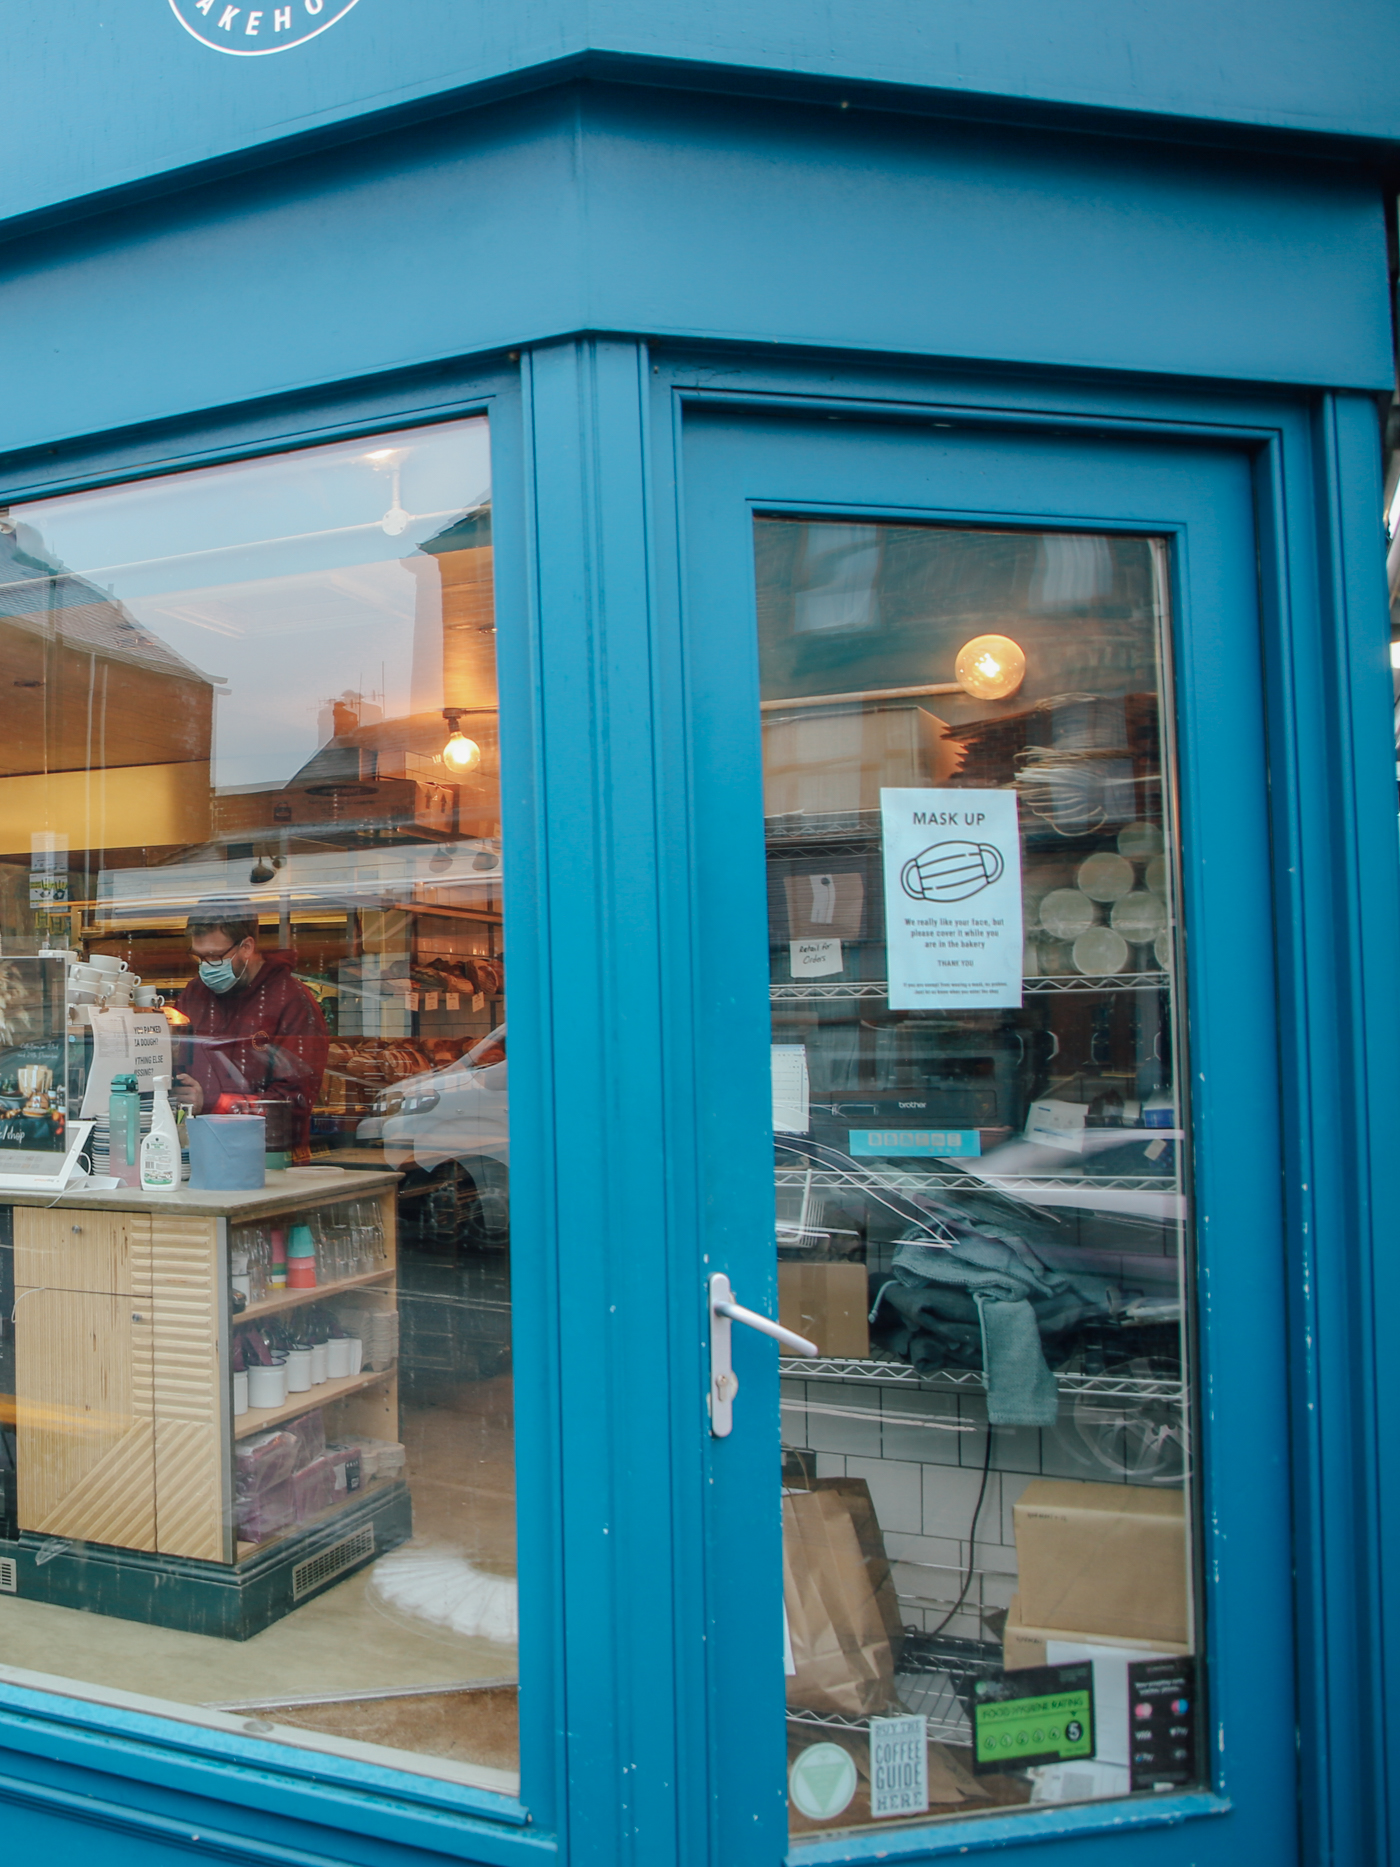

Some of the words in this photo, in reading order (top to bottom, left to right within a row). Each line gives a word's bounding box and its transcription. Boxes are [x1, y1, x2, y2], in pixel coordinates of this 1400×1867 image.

[912, 812, 958, 826] MASK
[964, 812, 986, 826] UP
[904, 918, 915, 926] We
[917, 918, 938, 927] really
[940, 918, 953, 926] like
[971, 918, 991, 927] face,
[992, 918, 1004, 926] but
[911, 929, 934, 938] please
[958, 929, 963, 937] it
[965, 929, 984, 937] while
[799, 945, 819, 953] Retail
[938, 940, 946, 948] in
[948, 940, 959, 948] the
[960, 940, 985, 949] bakery
[802, 954, 826, 964] Orders
[144, 1025, 162, 1034] PACKED
[141, 1038, 159, 1046] DOUGH?
[135, 1056, 152, 1065] YTHING
[152, 1055, 163, 1064] ELSE
[898, 1101, 927, 1109] brother
[983, 1707, 1010, 1719] FOOD
[1012, 1702, 1048, 1714] HYGIENE
[1051, 1697, 1084, 1709] RATING
[875, 1723, 896, 1736] BUY
[900, 1721, 920, 1732] THE
[1067, 1722, 1080, 1742] 5
[875, 1740, 922, 1764] COFFEE
[875, 1761, 922, 1790] GUIDE
[876, 1791, 923, 1811] HERE
